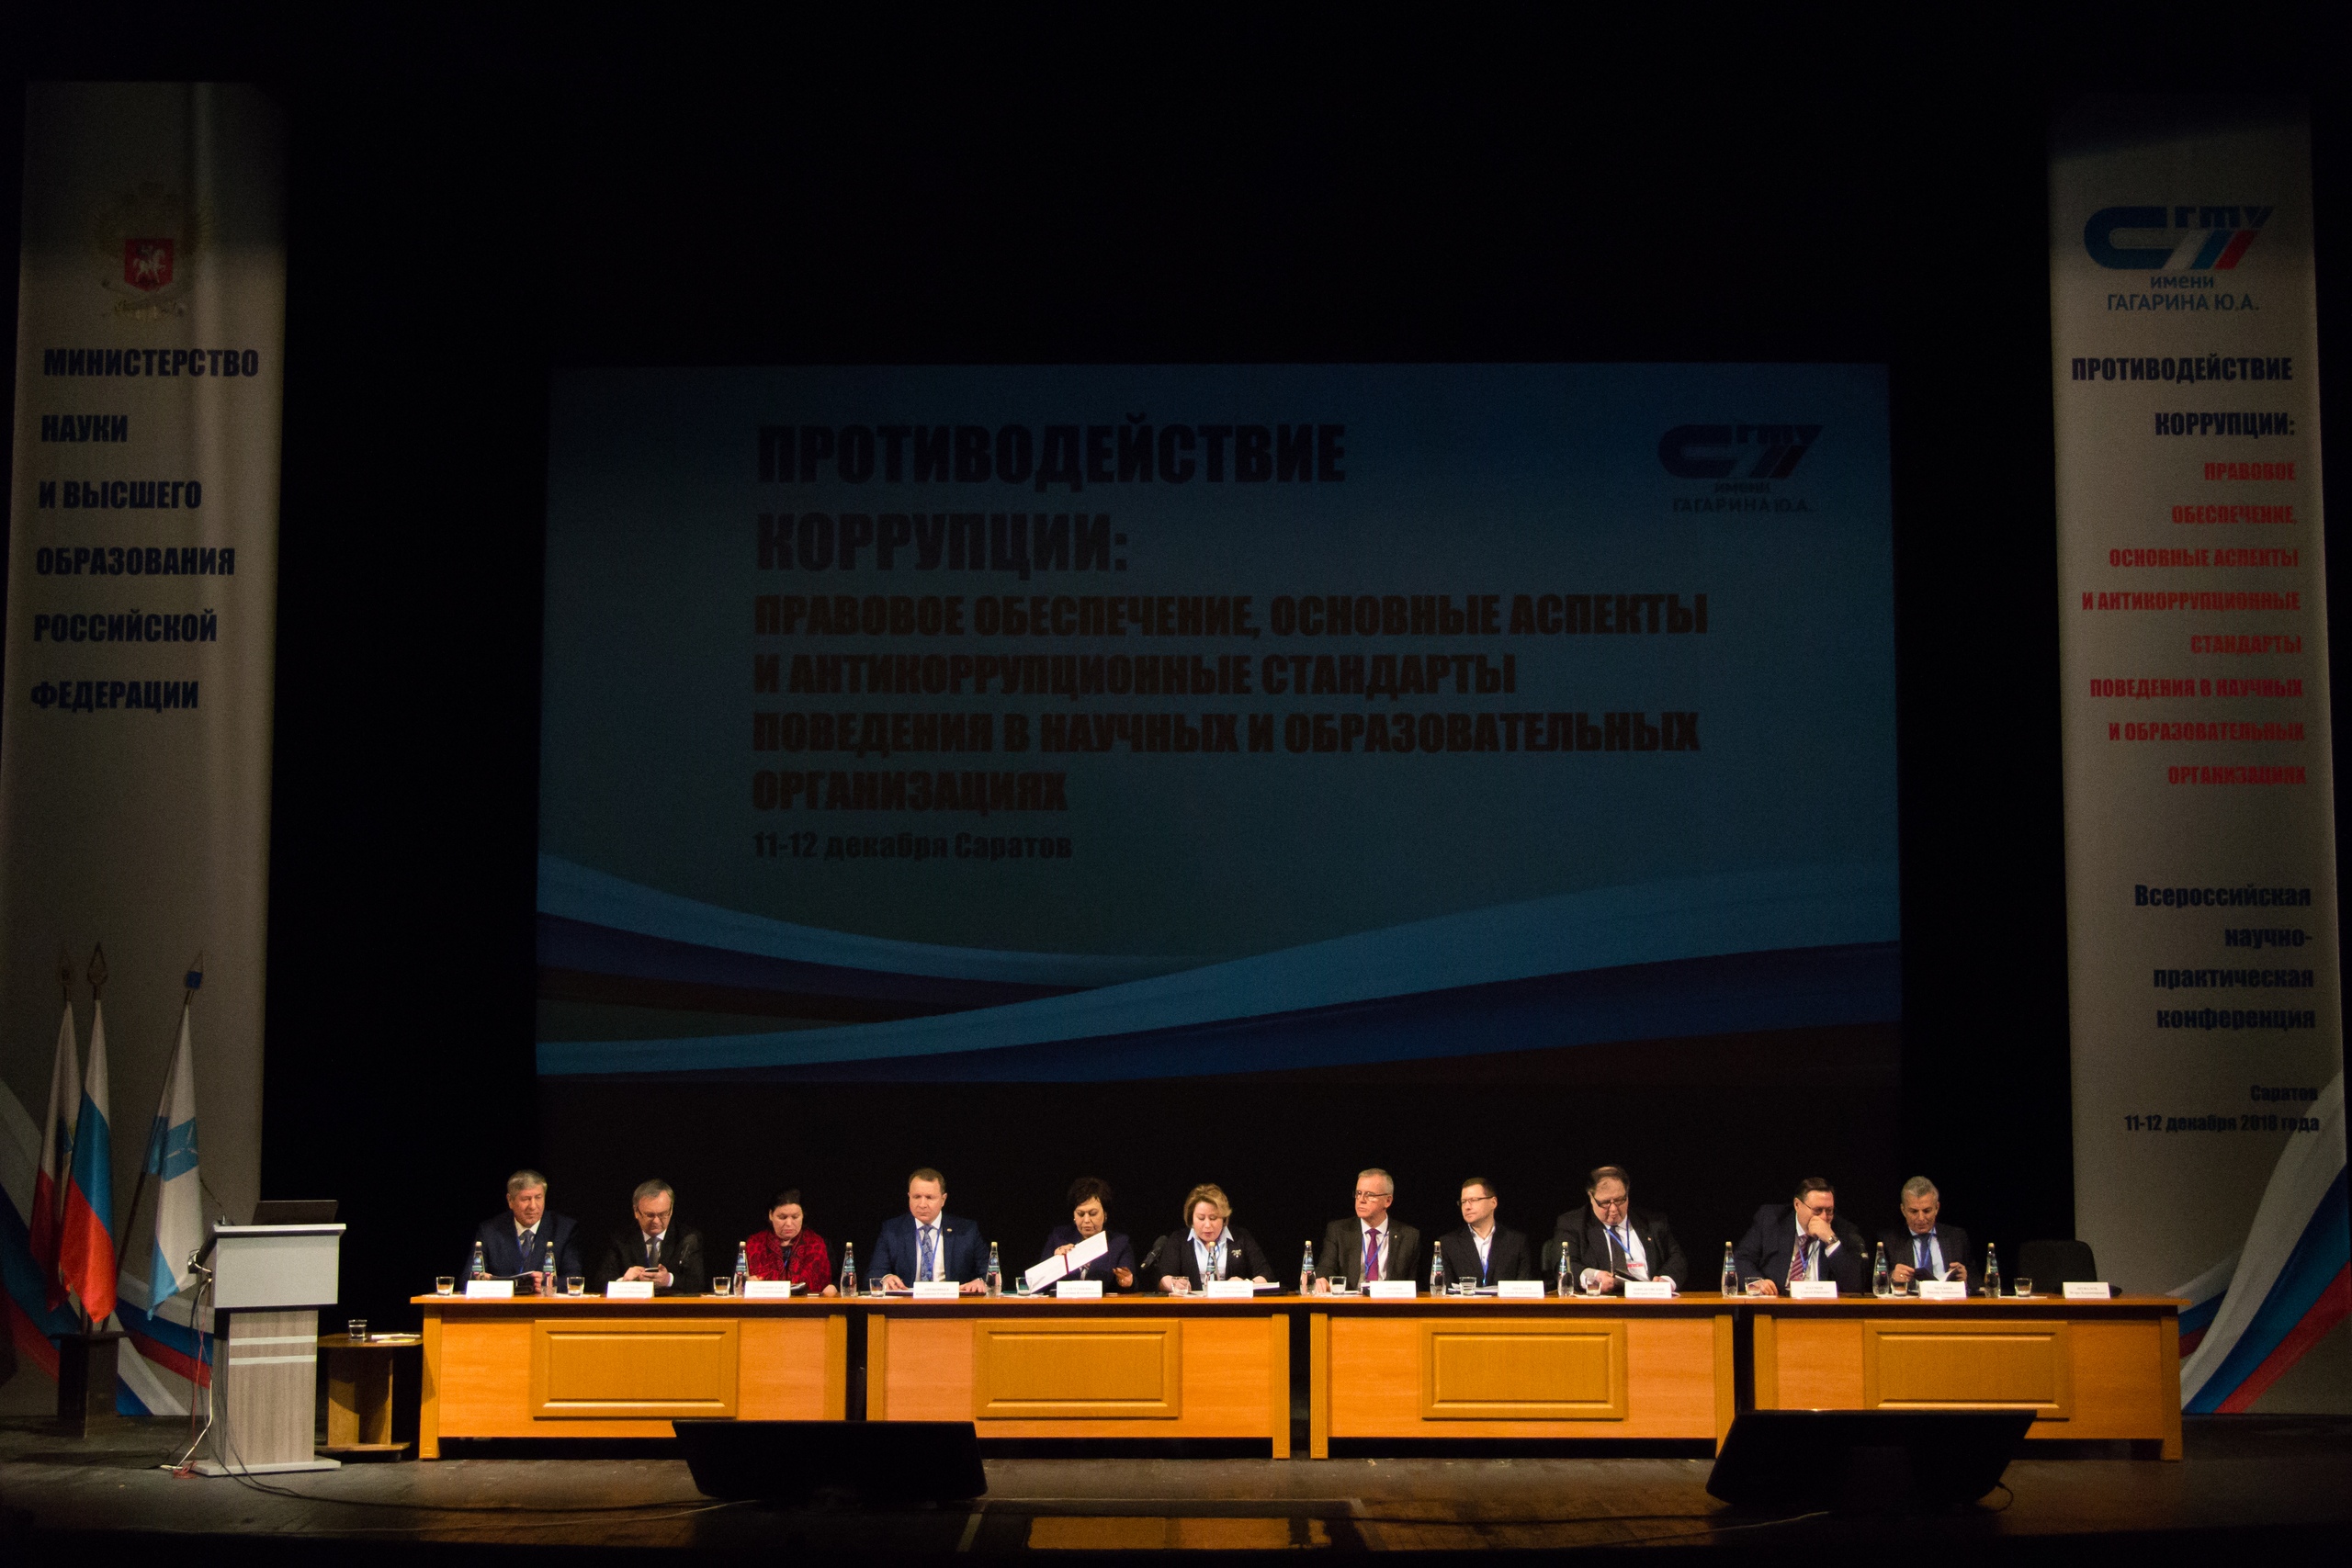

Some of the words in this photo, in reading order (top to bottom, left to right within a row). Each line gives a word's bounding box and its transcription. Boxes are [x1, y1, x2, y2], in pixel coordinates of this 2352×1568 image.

[2150, 276, 2214, 289] имени
[2108, 293, 2209, 311] ГАГАРИНА
[2214, 293, 2260, 311] Ю.А.
[44, 348, 259, 378] МИНИСТЕРСТВО
[2072, 354, 2293, 384] ПРОТИВОДЕЙСТВИЕ
[41, 414, 128, 443] НАУКИ
[2155, 412, 2296, 438] КОРРУПЦИИ:
[757, 412, 1346, 493] ПРОТИВОДЕЙСТВИЕ
[2204, 462, 2296, 481] ПРАВОВОЕ
[40, 480, 56, 509] И
[63, 480, 202, 509] ВЫСШЕГО
[1673, 498, 1770, 513] ГАГАРИНА
[2172, 504, 2298, 525] ОБЕСПЕЧЕНИЕ,
[757, 513, 1127, 581] КОРРУПЦИИ:
[2109, 548, 2211, 568] ОСНОВНЫЕ
[2213, 548, 2299, 568] АСПЕКТЫ
[36, 547, 236, 576] ОБРАЗОВАНИЯ
[2082, 592, 2095, 611] И
[2098, 592, 2301, 614] АНТИКОРРУПЦИОННЫЕ
[33, 607, 218, 643] РОССИЙСКОЙ
[755, 594, 963, 637] ПРАВОВОЕ
[974, 594, 1261, 640] ОБЕСПЕЧЕНИЕ,
[1272, 594, 1499, 635] ОСНОВНЫЕ
[1510, 594, 1707, 635] АСПЕКТЫ
[2190, 635, 2302, 658] СТАНДАРТЫ
[753, 654, 780, 694] И
[788, 653, 1251, 700] АНТИКОРРУПЦИОННЫЕ
[1262, 653, 1516, 701] СТАНДАРТЫ
[2090, 678, 2196, 701] ПОВЕДЕНИЯ
[2199, 679, 2212, 697] В
[2215, 678, 2303, 698] НАУЧНЫХ
[30, 680, 199, 713] ФЕДЕРАЦИИ
[753, 712, 993, 758] ПОВЕДЕНИЯ
[1004, 713, 1030, 753] В
[1041, 712, 1238, 753] НАУЧНЫХ
[1248, 713, 1273, 753] И
[1285, 712, 1701, 753] ОБРАЗОВАТЕЛЬНЫХ
[2109, 722, 2121, 742] И
[2124, 721, 2306, 742] ОБРАЗОВАТЕЛЬНЫХ
[2167, 765, 2307, 788] ОРГАНИЗАЦИЯХ
[752, 771, 1069, 817] ОРГАНИЗАЦИЯХ
[752, 834, 818, 858] 11-12
[824, 832, 948, 861] декабря
[954, 833, 1073, 861] Саратов
[2134, 883, 2312, 909] Всероссийская
[2224, 927, 2313, 950] научно-
[2153, 968, 2314, 990] практическая
[2156, 1008, 2316, 1032] конференция
[2250, 1084, 2318, 1103] Саратов
[2124, 1114, 2162, 1132] 11-12
[2165, 1114, 2237, 1134] декабря
[2240, 1114, 2278, 1132] 2018
[2281, 1116, 2320, 1134] года
